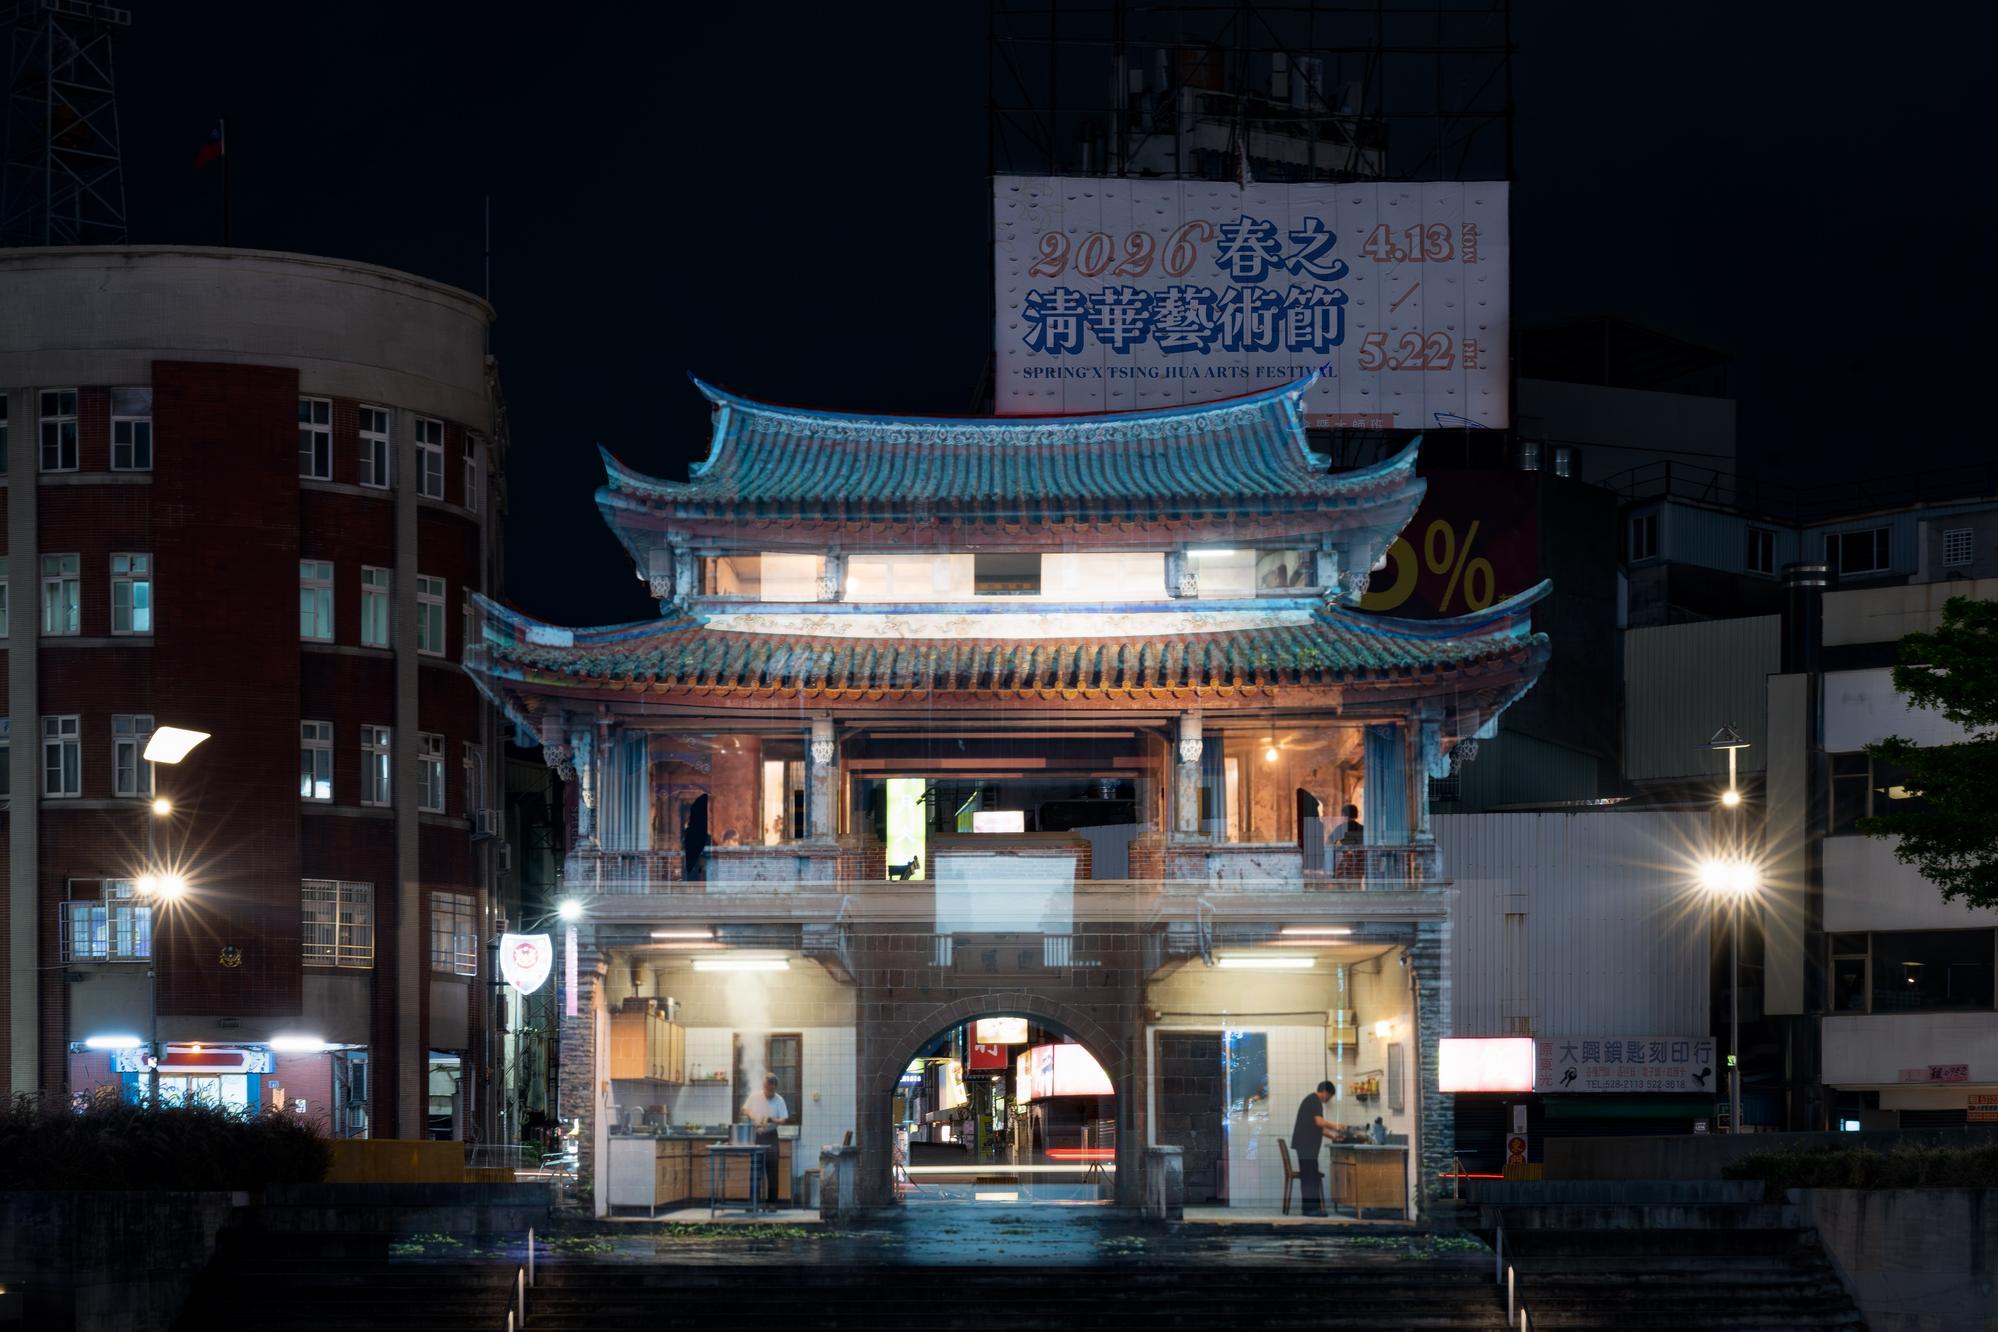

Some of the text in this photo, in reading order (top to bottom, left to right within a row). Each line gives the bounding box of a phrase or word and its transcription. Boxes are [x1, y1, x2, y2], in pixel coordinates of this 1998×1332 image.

[1029, 214, 1349, 283] 2026 春之
[1363, 223, 1454, 263] 4.13
[1462, 222, 1477, 264] MON
[1022, 284, 1349, 355] 清華藝術節
[1359, 331, 1455, 371] 5.22
[1462, 338, 1477, 369] FRI
[1023, 366, 1087, 379] SPRING
[1107, 366, 1159, 379] TSING
[1164, 366, 1200, 379] HUA
[1204, 366, 1249, 379] ARTS
[1559, 1040, 1712, 1064] 大興鎖匙刻印行
